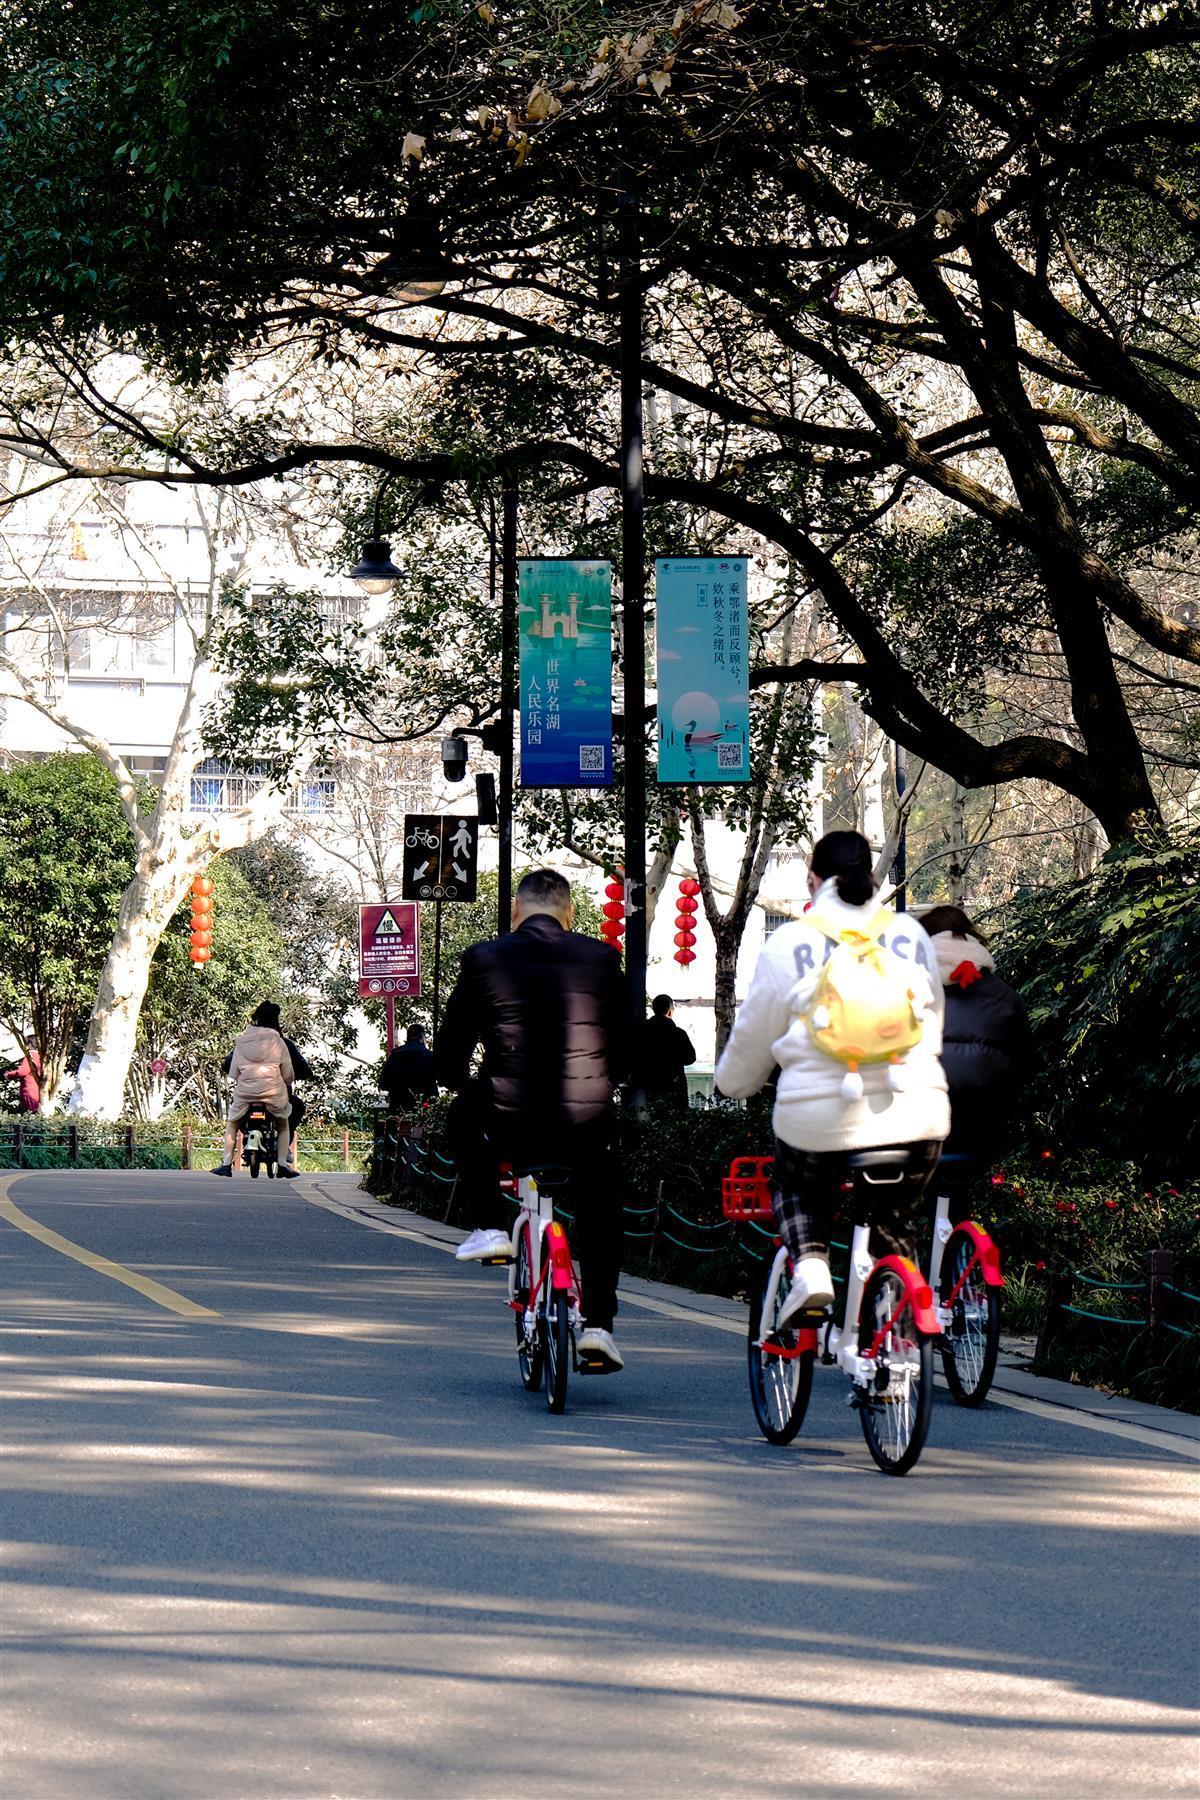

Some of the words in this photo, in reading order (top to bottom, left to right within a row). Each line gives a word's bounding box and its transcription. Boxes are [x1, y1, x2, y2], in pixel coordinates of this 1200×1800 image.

[527, 675, 542, 745] 人民乐园
[546, 659, 560, 730] 世界名湖
